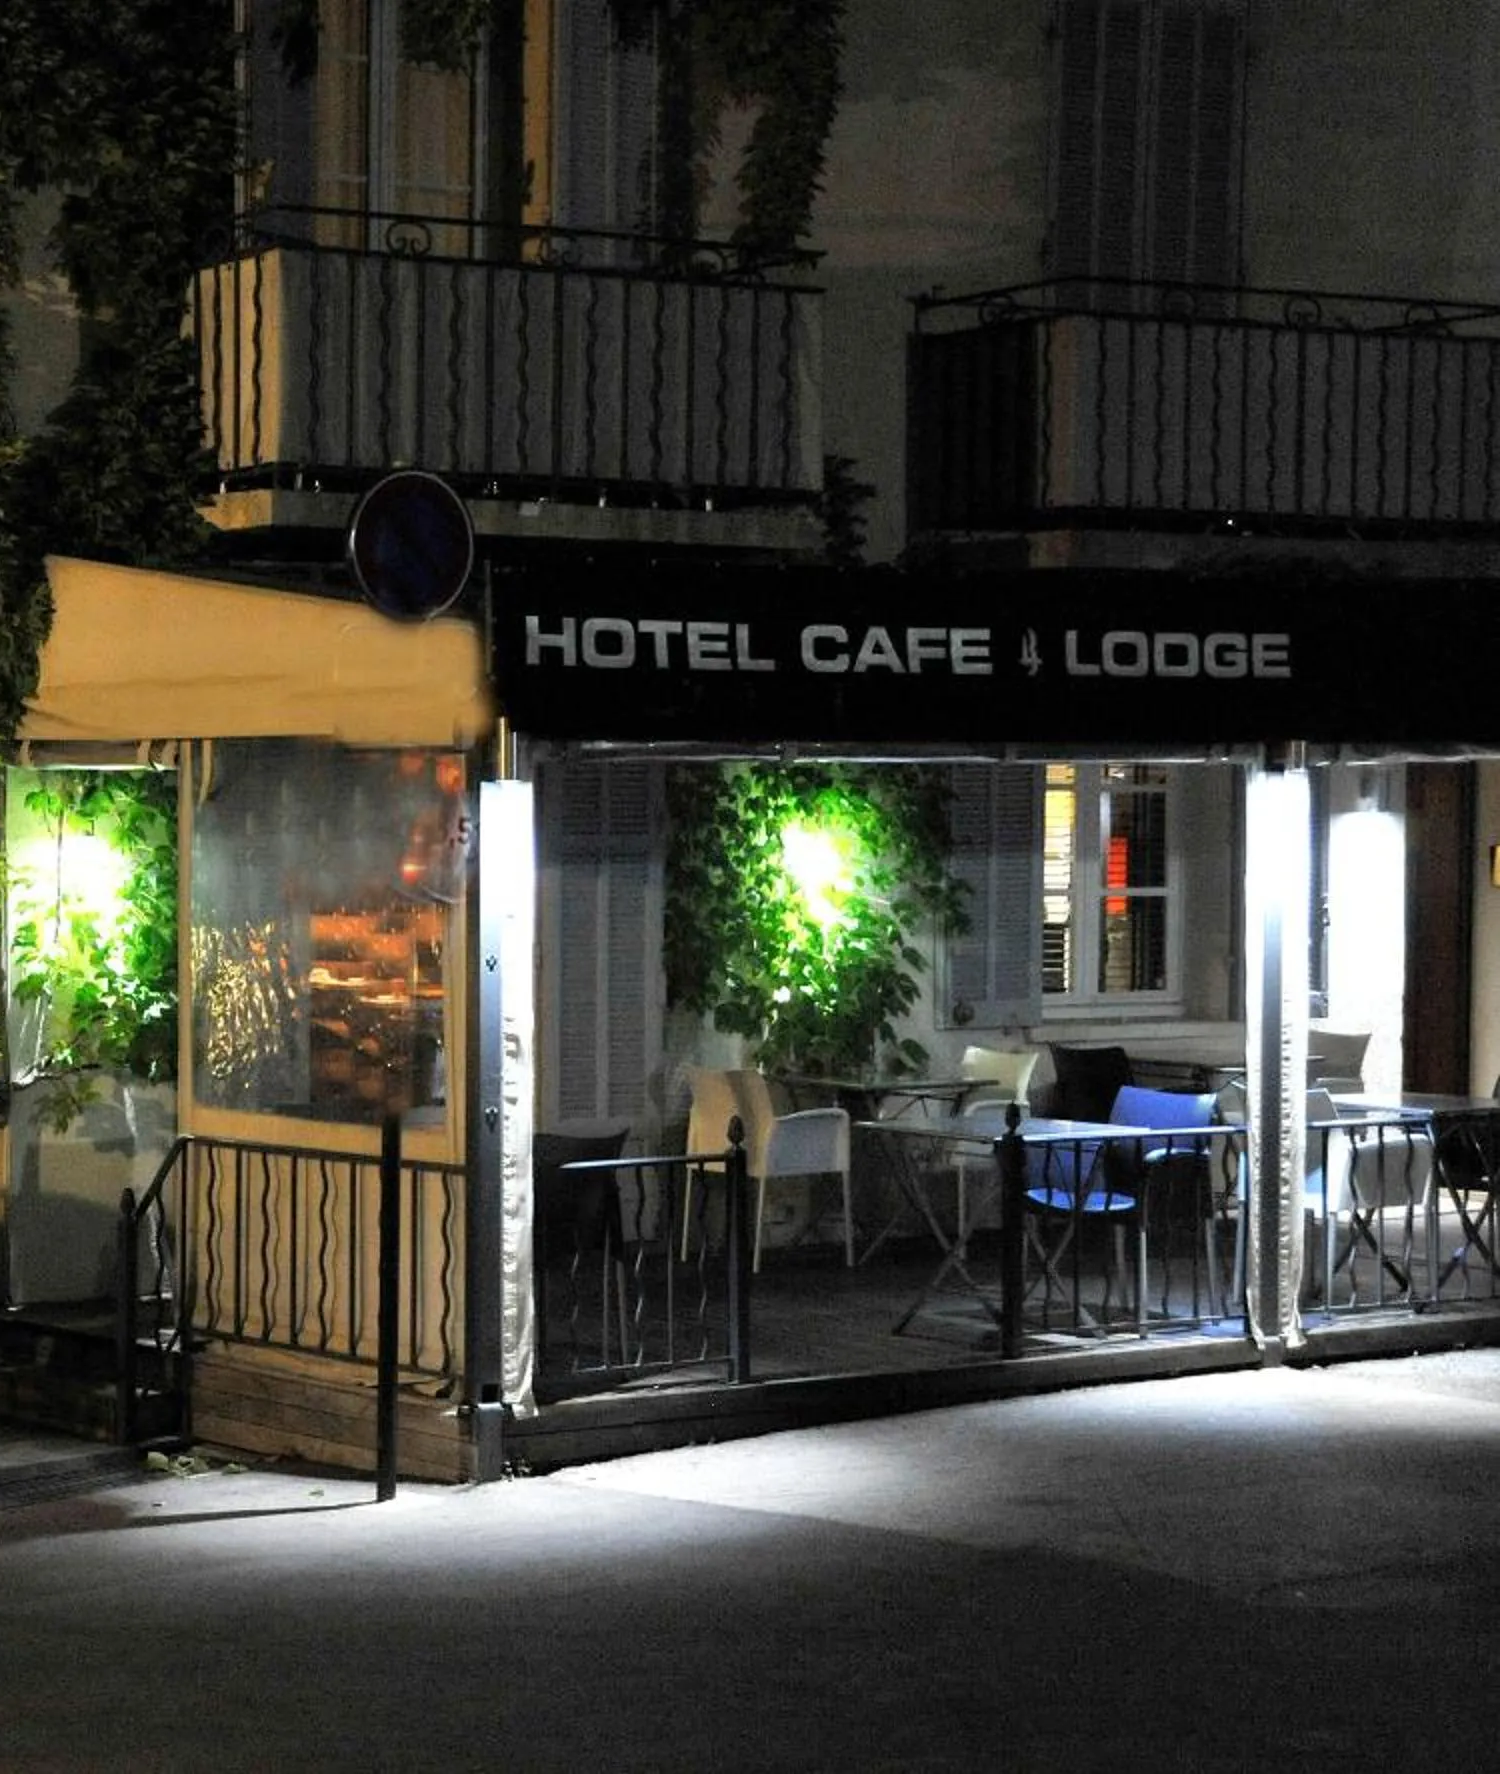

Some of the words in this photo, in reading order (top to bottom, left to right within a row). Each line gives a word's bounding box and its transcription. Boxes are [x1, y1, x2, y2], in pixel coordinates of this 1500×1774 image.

[525, 615, 775, 671] HOTEL
[800, 624, 993, 674] CAFE
[1065, 630, 1291, 677] LODGE
